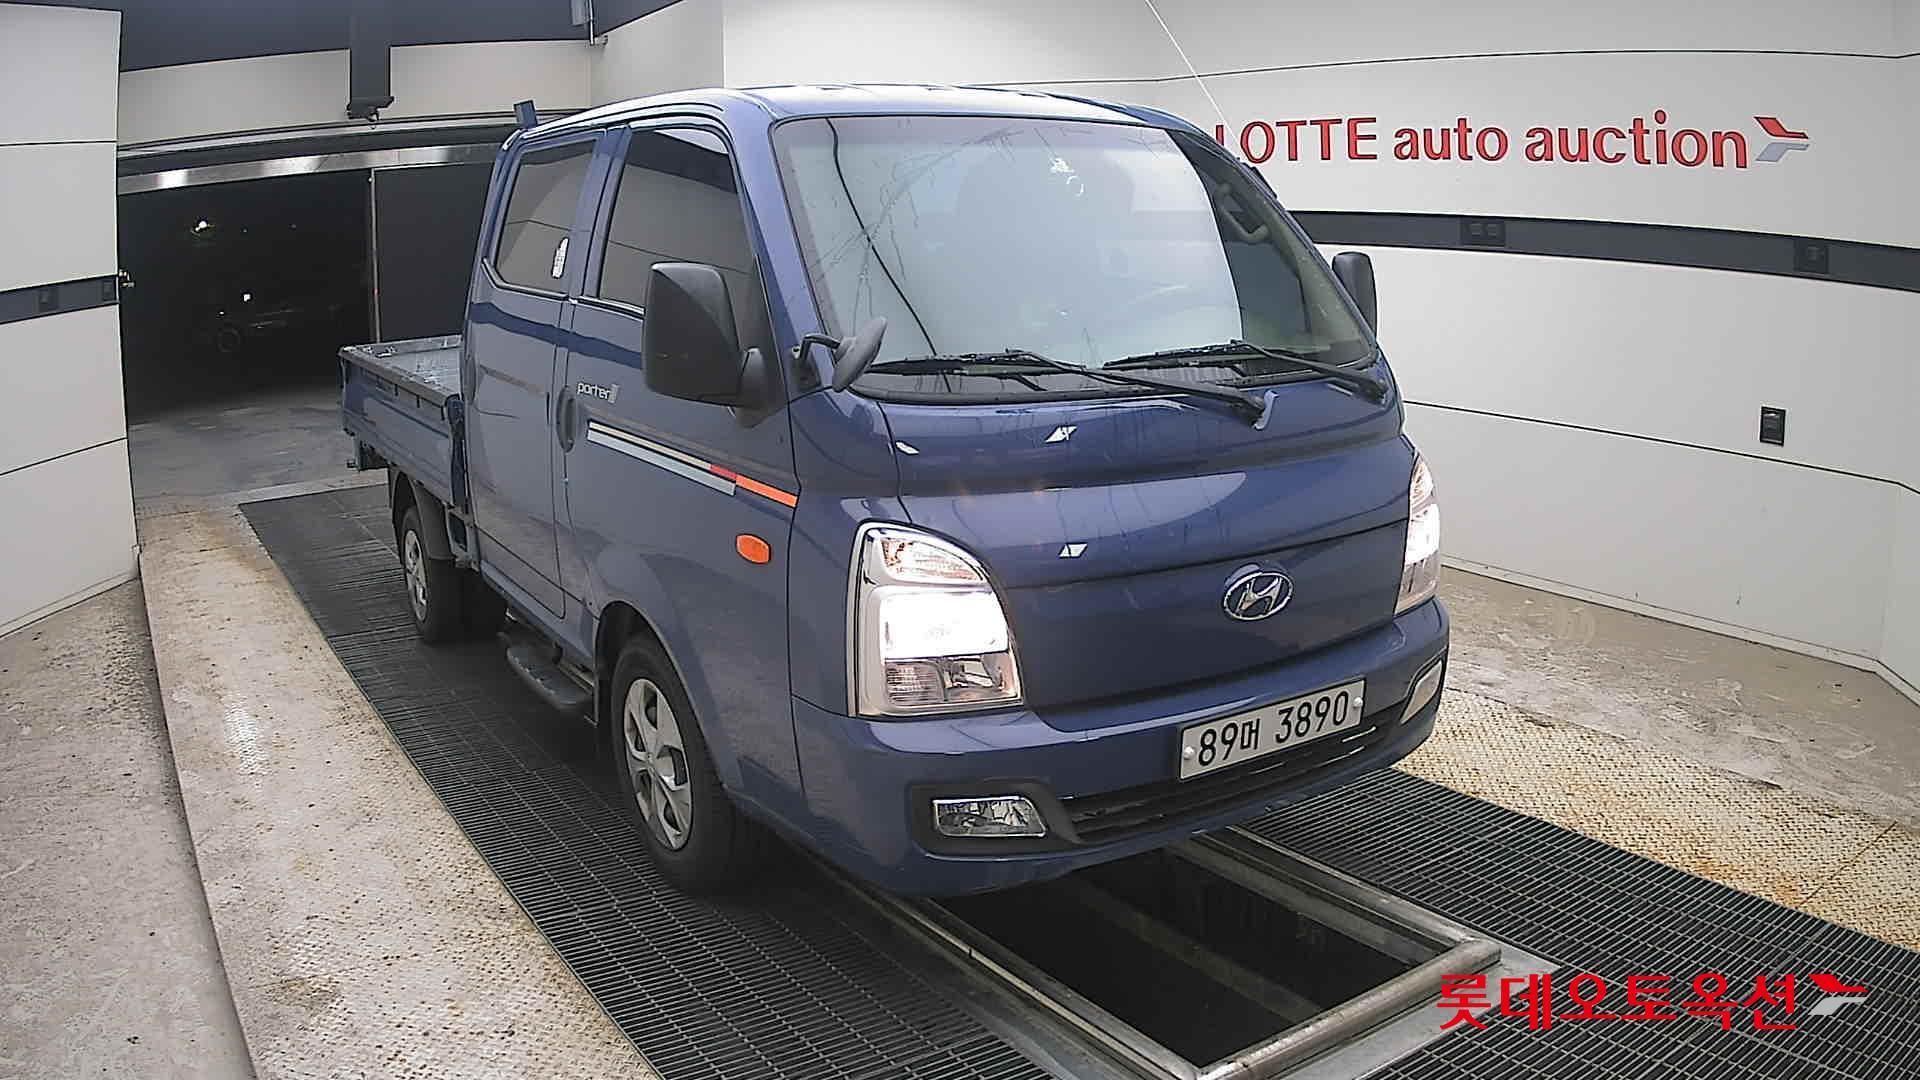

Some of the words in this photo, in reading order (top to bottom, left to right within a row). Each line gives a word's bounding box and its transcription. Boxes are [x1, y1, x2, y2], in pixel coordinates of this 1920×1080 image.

[1393, 117, 1508, 161] auto
[1525, 110, 1748, 168] auction
[1198, 718, 1260, 766] 89머
[1275, 691, 1349, 743] 3890
